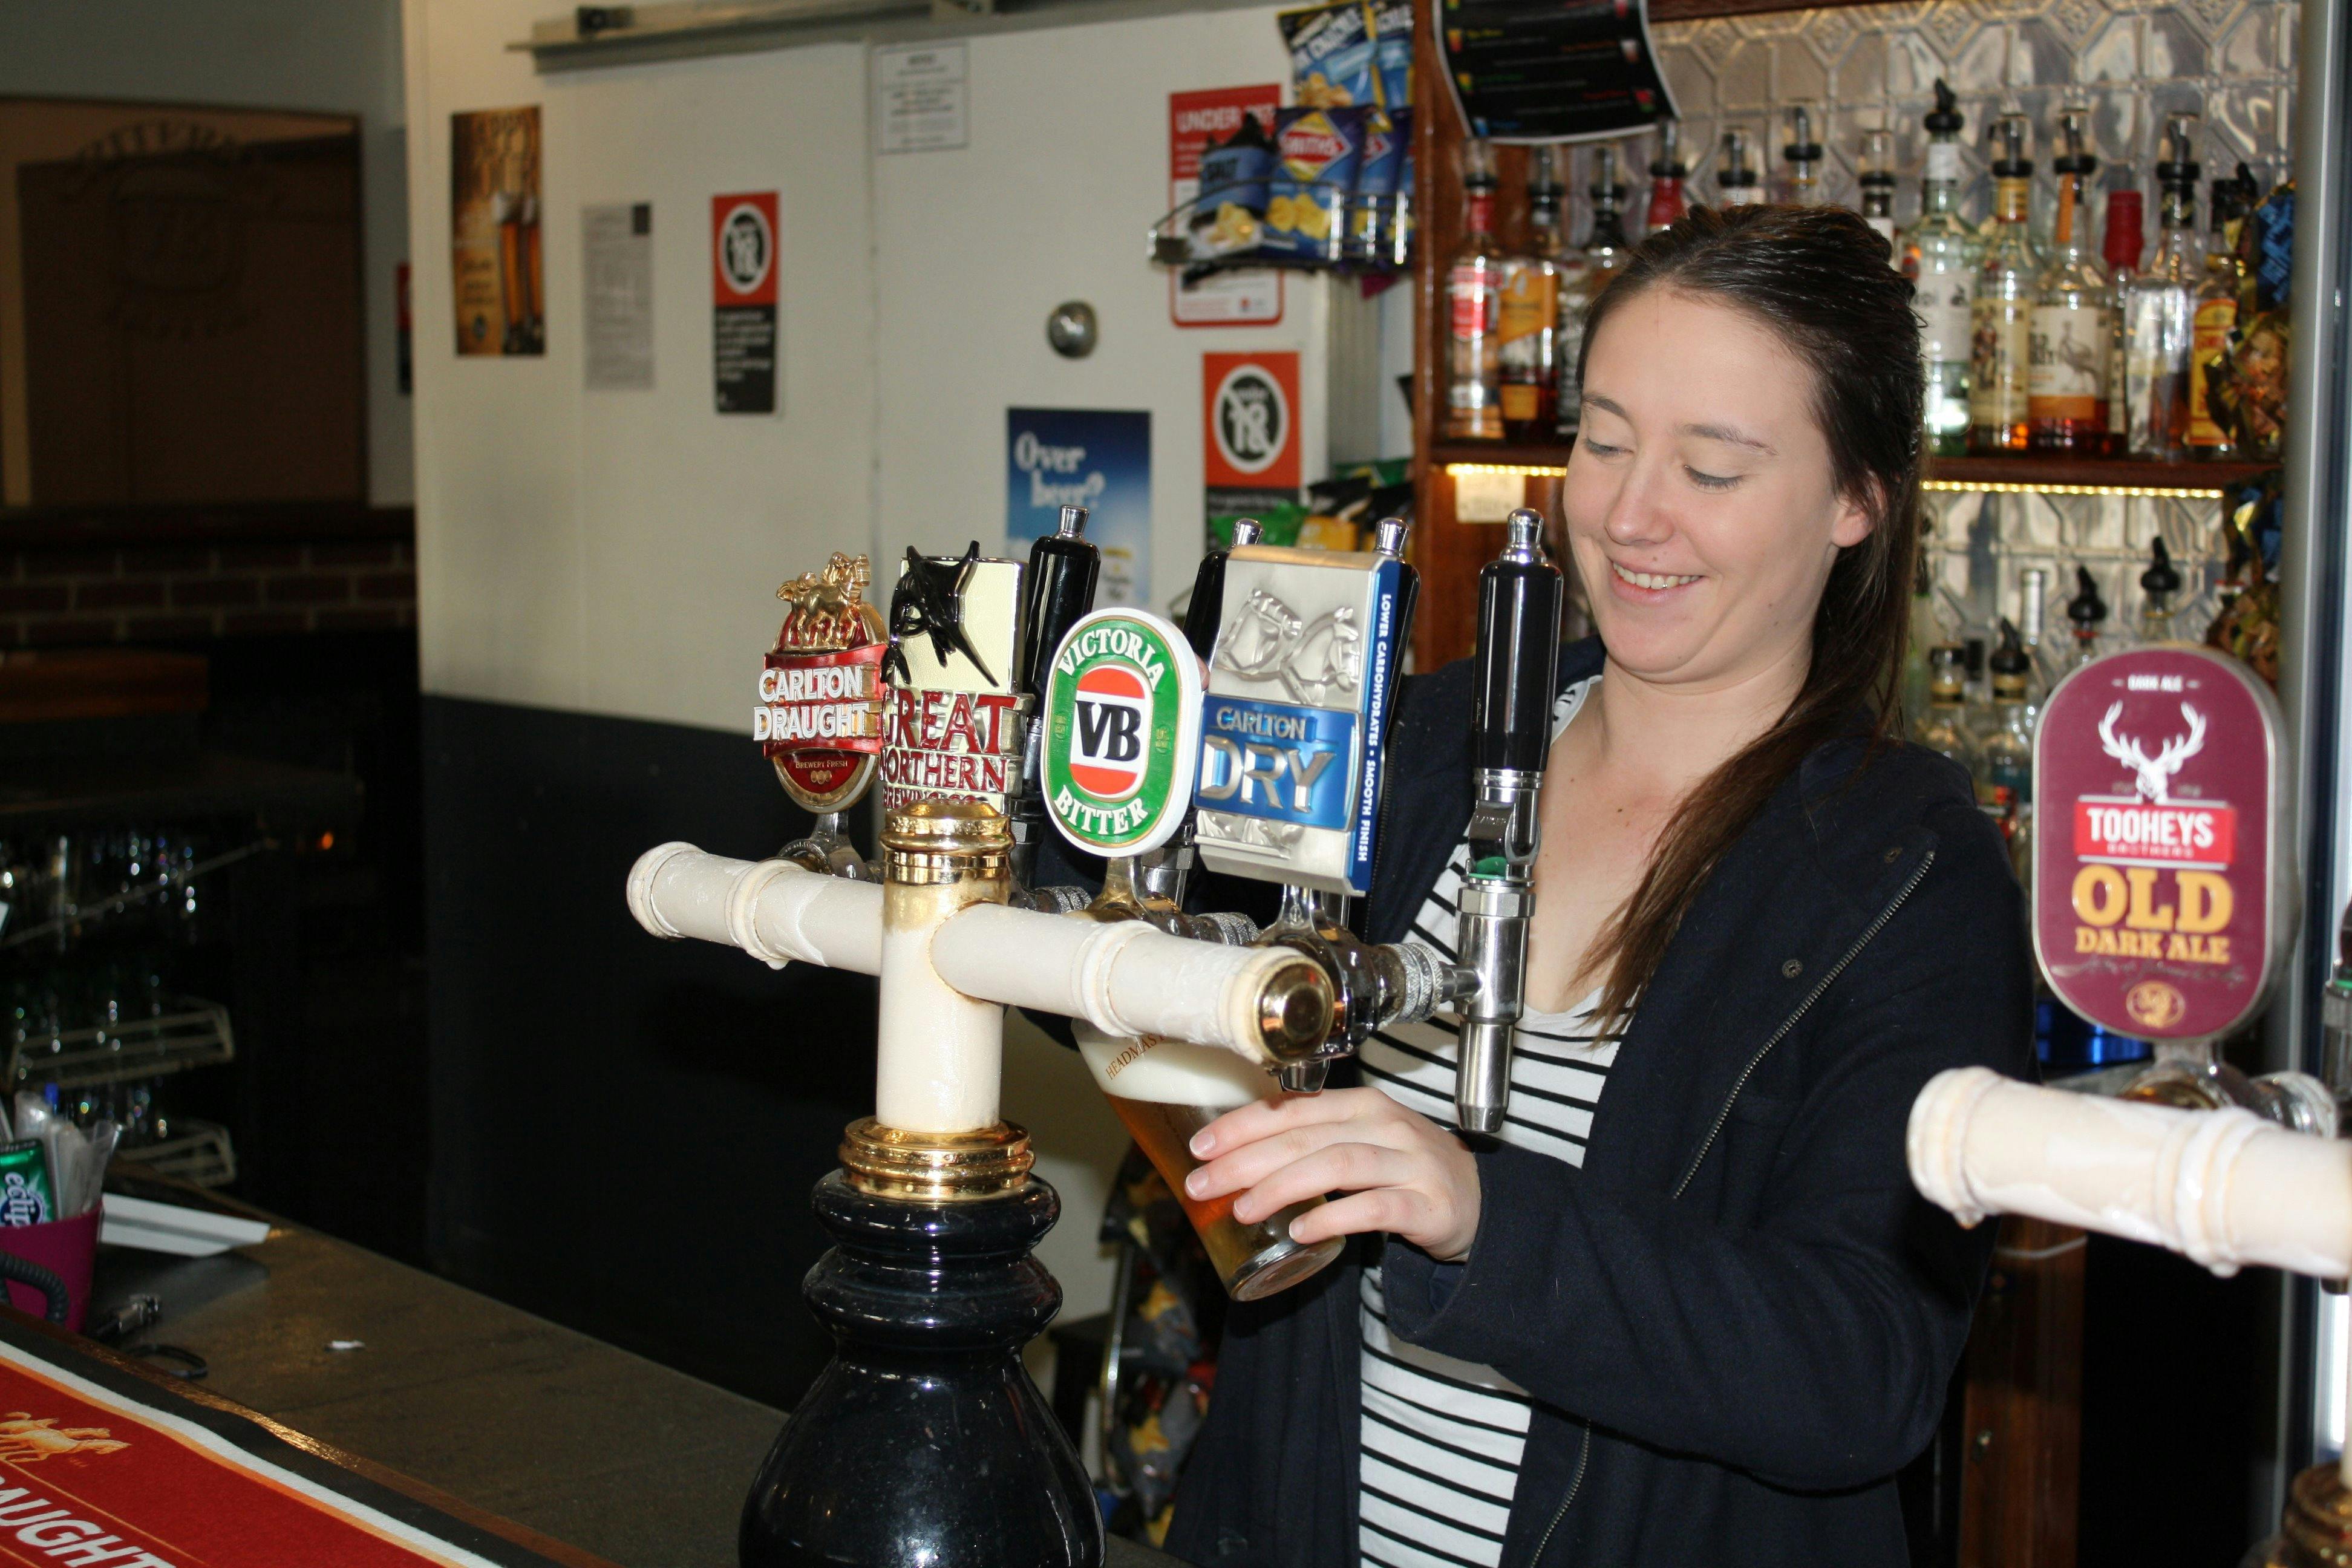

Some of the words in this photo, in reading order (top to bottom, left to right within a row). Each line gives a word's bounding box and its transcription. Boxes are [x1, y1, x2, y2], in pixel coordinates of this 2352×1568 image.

[1014, 430, 1088, 474] Over
[1031, 469, 1107, 509] beer?
[1378, 593, 1392, 638] LOWER
[1058, 628, 1165, 693] VICTORIA
[759, 665, 863, 704] CARLTON
[1368, 641, 1388, 746] CARBOHYDRATES
[753, 702, 869, 742] DRAUGHT
[881, 688, 1018, 756] GREAT
[1075, 700, 1142, 762] VB
[1216, 705, 1307, 741] CARLTON
[795, 760, 825, 769] BREWERY
[826, 759, 848, 768] FRESH
[1200, 734, 1338, 813] DRY
[1054, 784, 1149, 836] BITTER
[1362, 759, 1377, 816] SMOOTH
[1357, 819, 1371, 861] FINISH
[2086, 807, 2215, 849] TOOHEYS
[2071, 863, 2235, 935] OLD
[2075, 926, 2164, 960] DARK
[2165, 932, 2231, 965] ALE
[1105, 1033, 1166, 1080] HEADMAS
